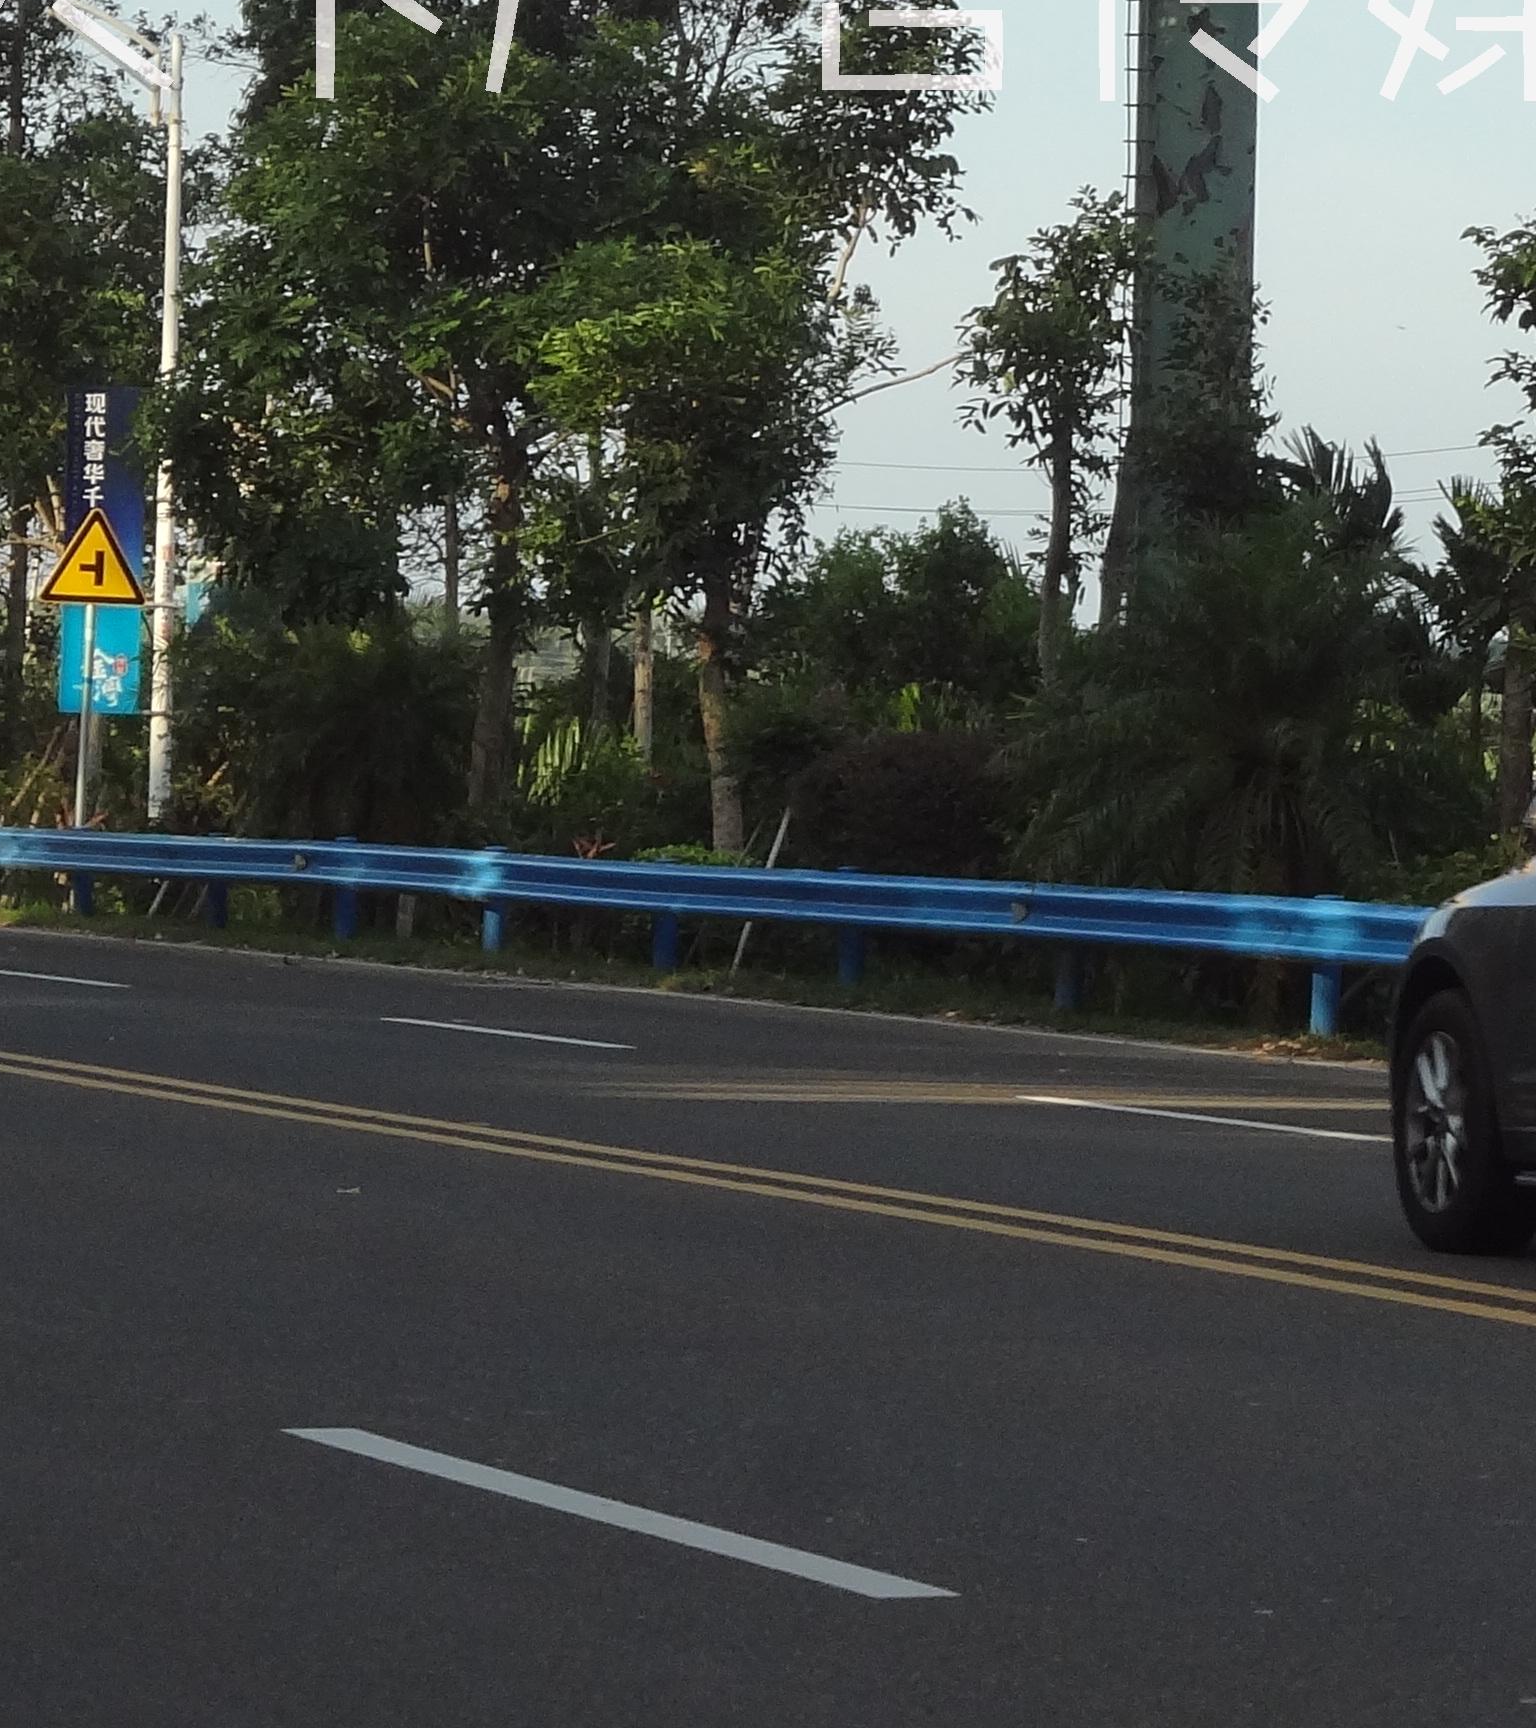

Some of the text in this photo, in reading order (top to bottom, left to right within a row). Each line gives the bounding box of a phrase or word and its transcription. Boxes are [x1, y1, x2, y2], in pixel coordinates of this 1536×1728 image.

[82, 392, 107, 509] 现代奢华千
